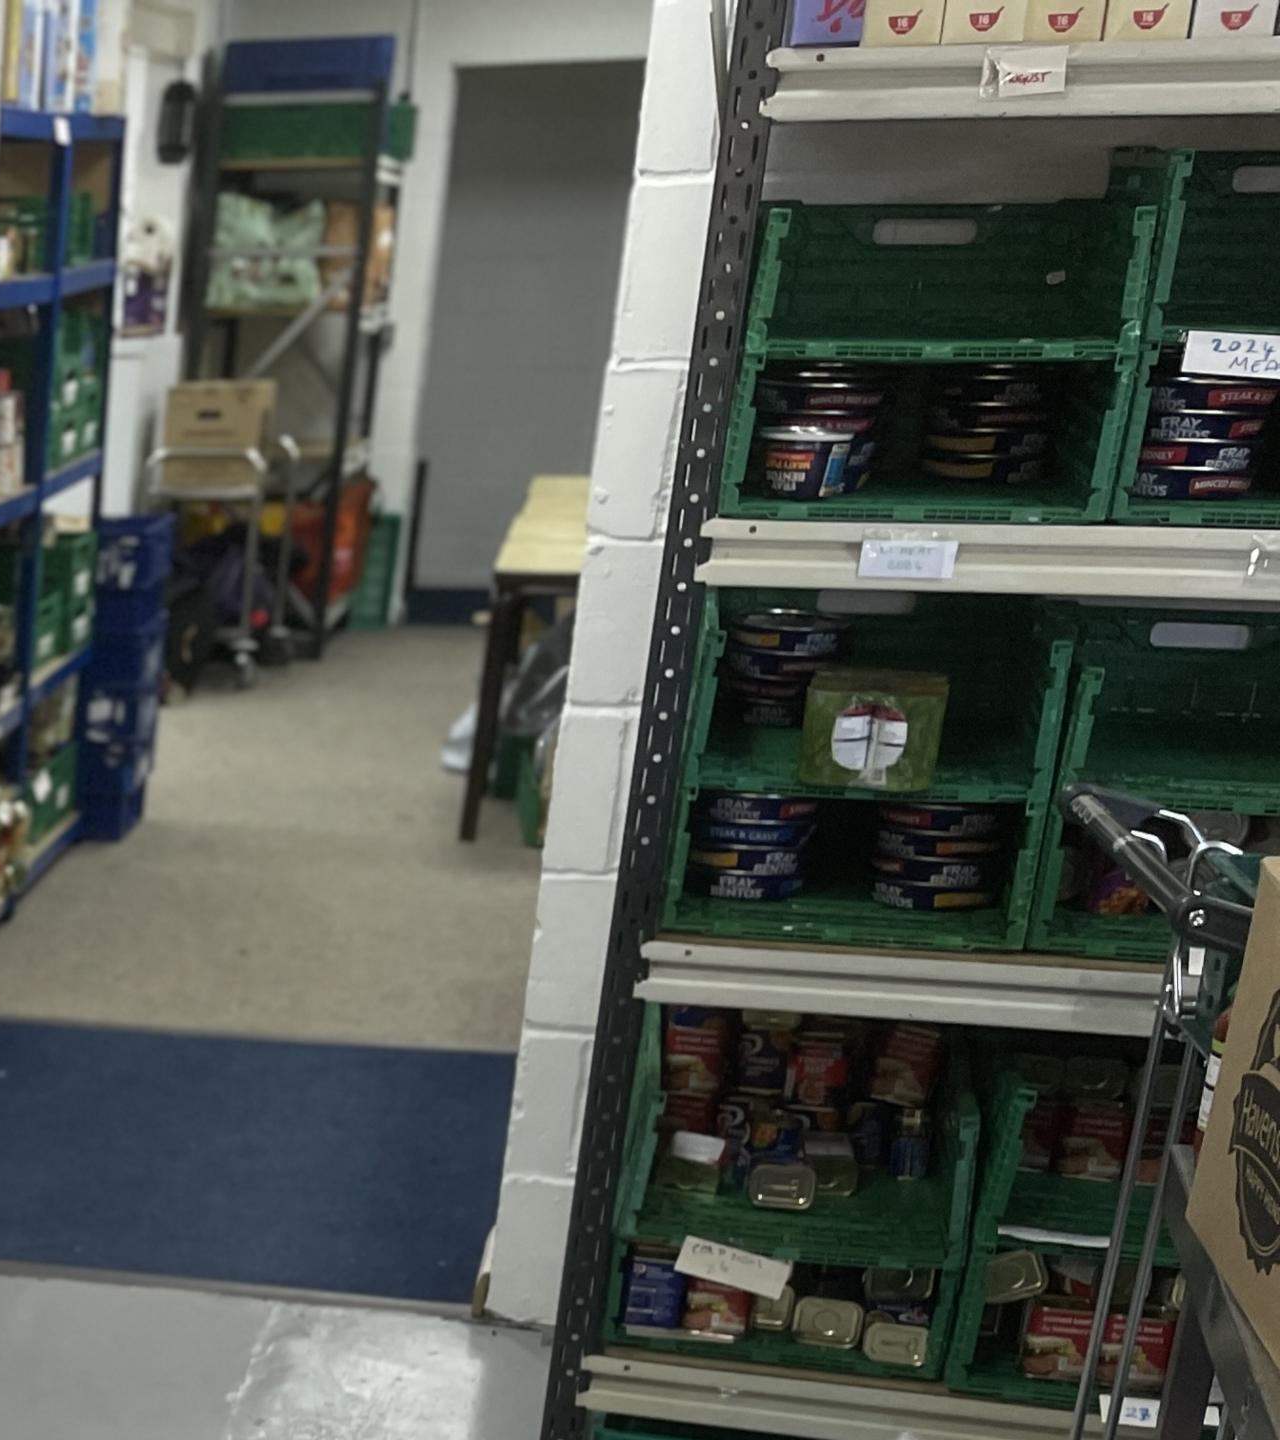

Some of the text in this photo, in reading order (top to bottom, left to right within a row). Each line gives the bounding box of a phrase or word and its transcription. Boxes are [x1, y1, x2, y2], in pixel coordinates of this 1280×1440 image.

[1211, 337, 1277, 362] 2024
[1227, 356, 1280, 373] MEA
[1160, 416, 1203, 430] FRAY
